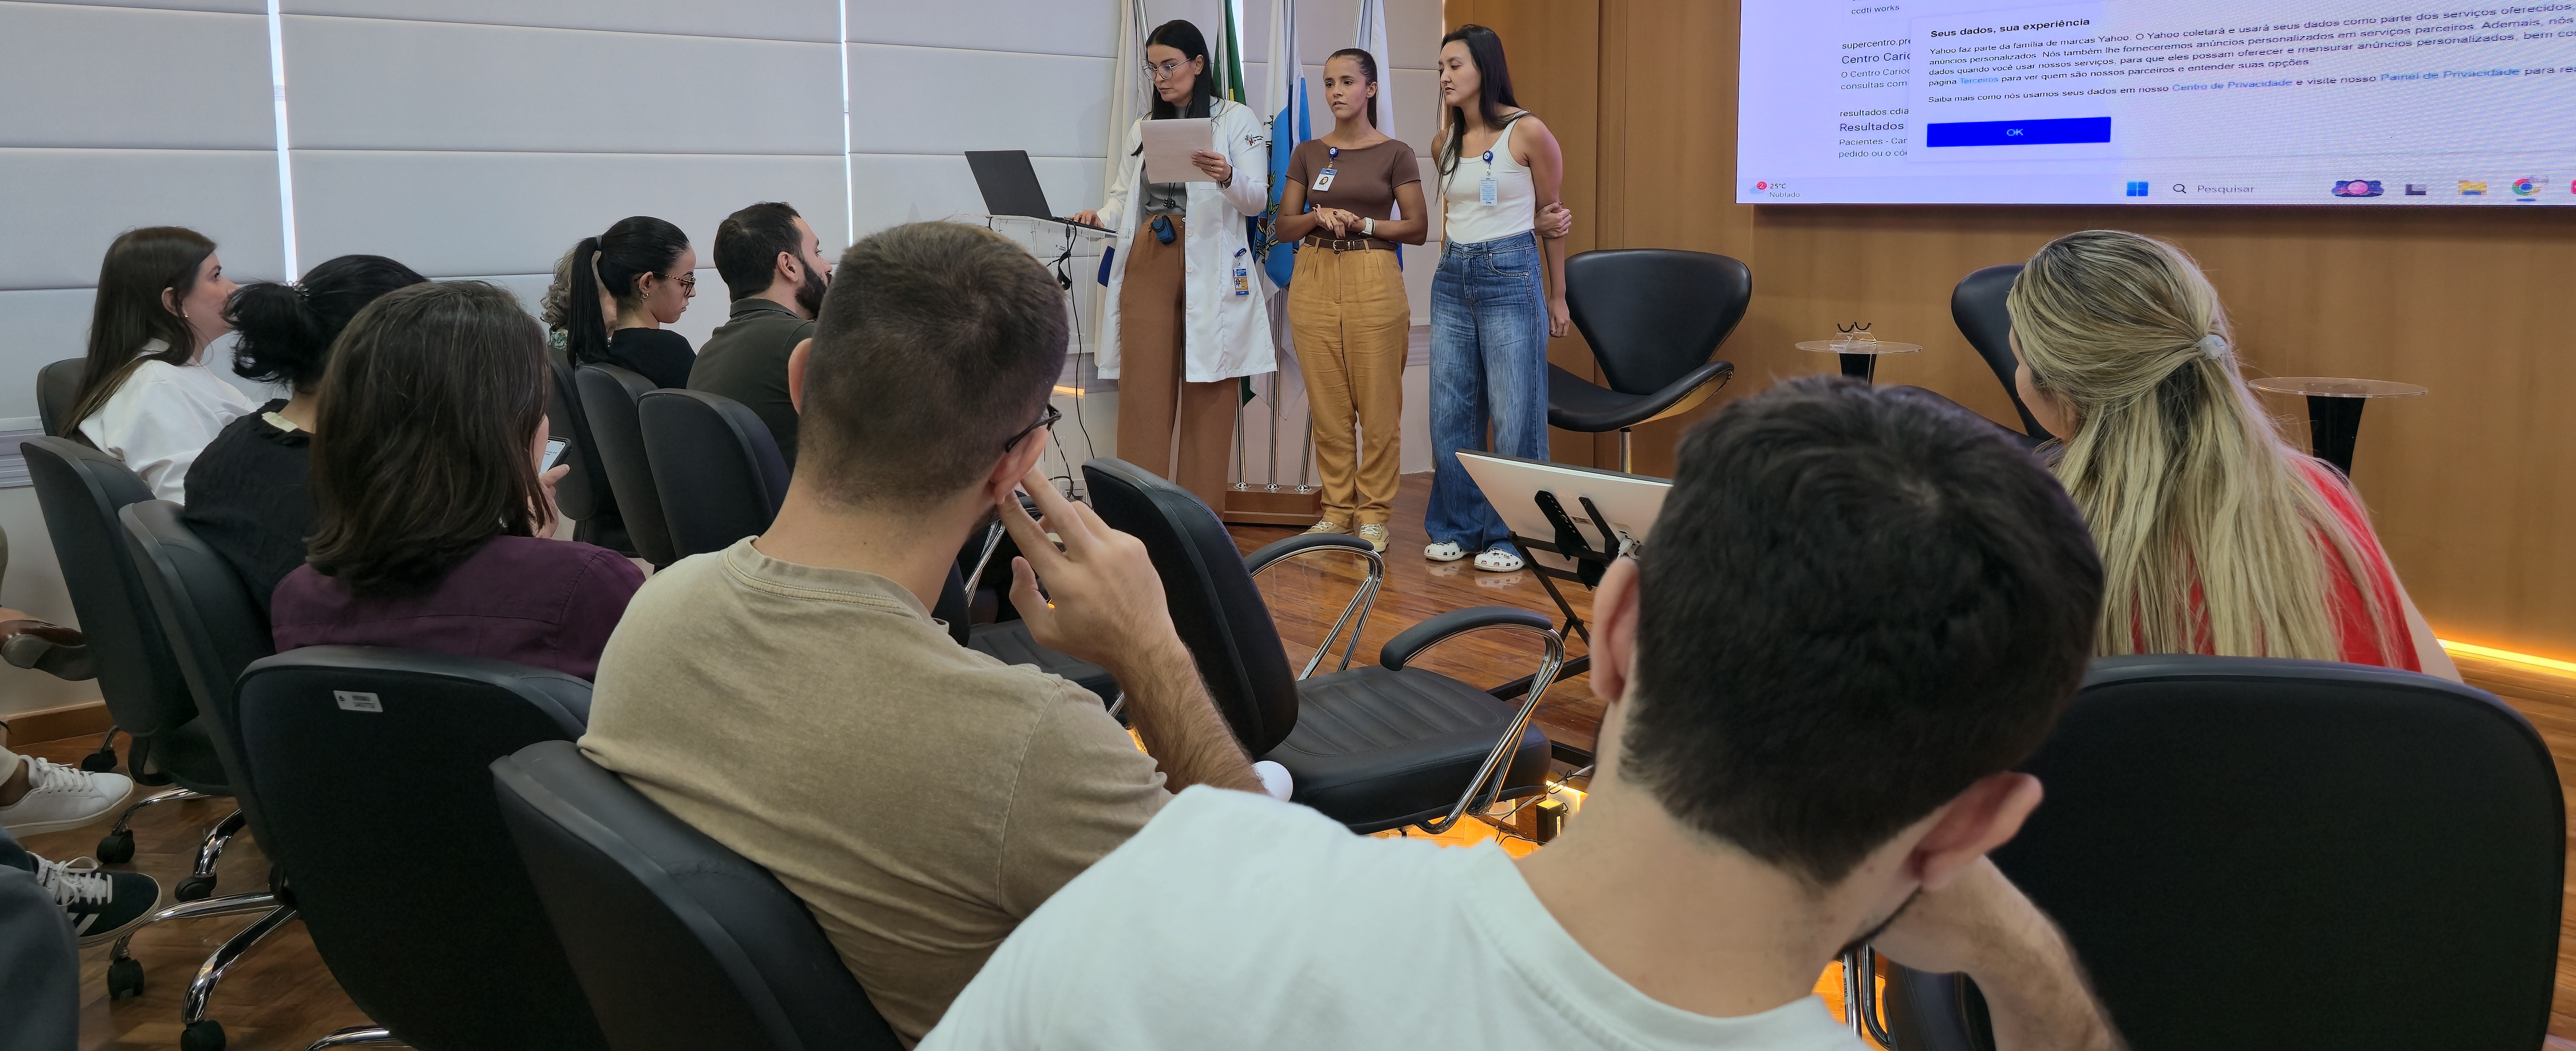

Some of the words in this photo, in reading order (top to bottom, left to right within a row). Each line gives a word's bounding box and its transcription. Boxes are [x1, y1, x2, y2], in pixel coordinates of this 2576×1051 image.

[1960, 27, 1996, 35] dados,
[2023, 19, 2090, 30] experiência
[2183, 28, 2224, 36] coletará
[2381, 15, 2411, 23] parte
[2444, 9, 2496, 18] serviços
[2124, 43, 2192, 52] forneceremos
[2197, 39, 2244, 47] anúncios
[2360, 28, 2410, 36] serviços
[1842, 56, 1879, 64] Centro
[1957, 66, 1989, 74] quando
[2193, 51, 2234, 60] possam
[2358, 41, 2412, 49] anúncios
[1929, 79, 1956, 87] página
[2228, 79, 2292, 88] Privacidade
[2444, 69, 2519, 78] Privacidade
[1840, 122, 1904, 131] Resultados
[1839, 150, 1869, 158] pedido
[2198, 185, 2254, 193] Pesquisar
